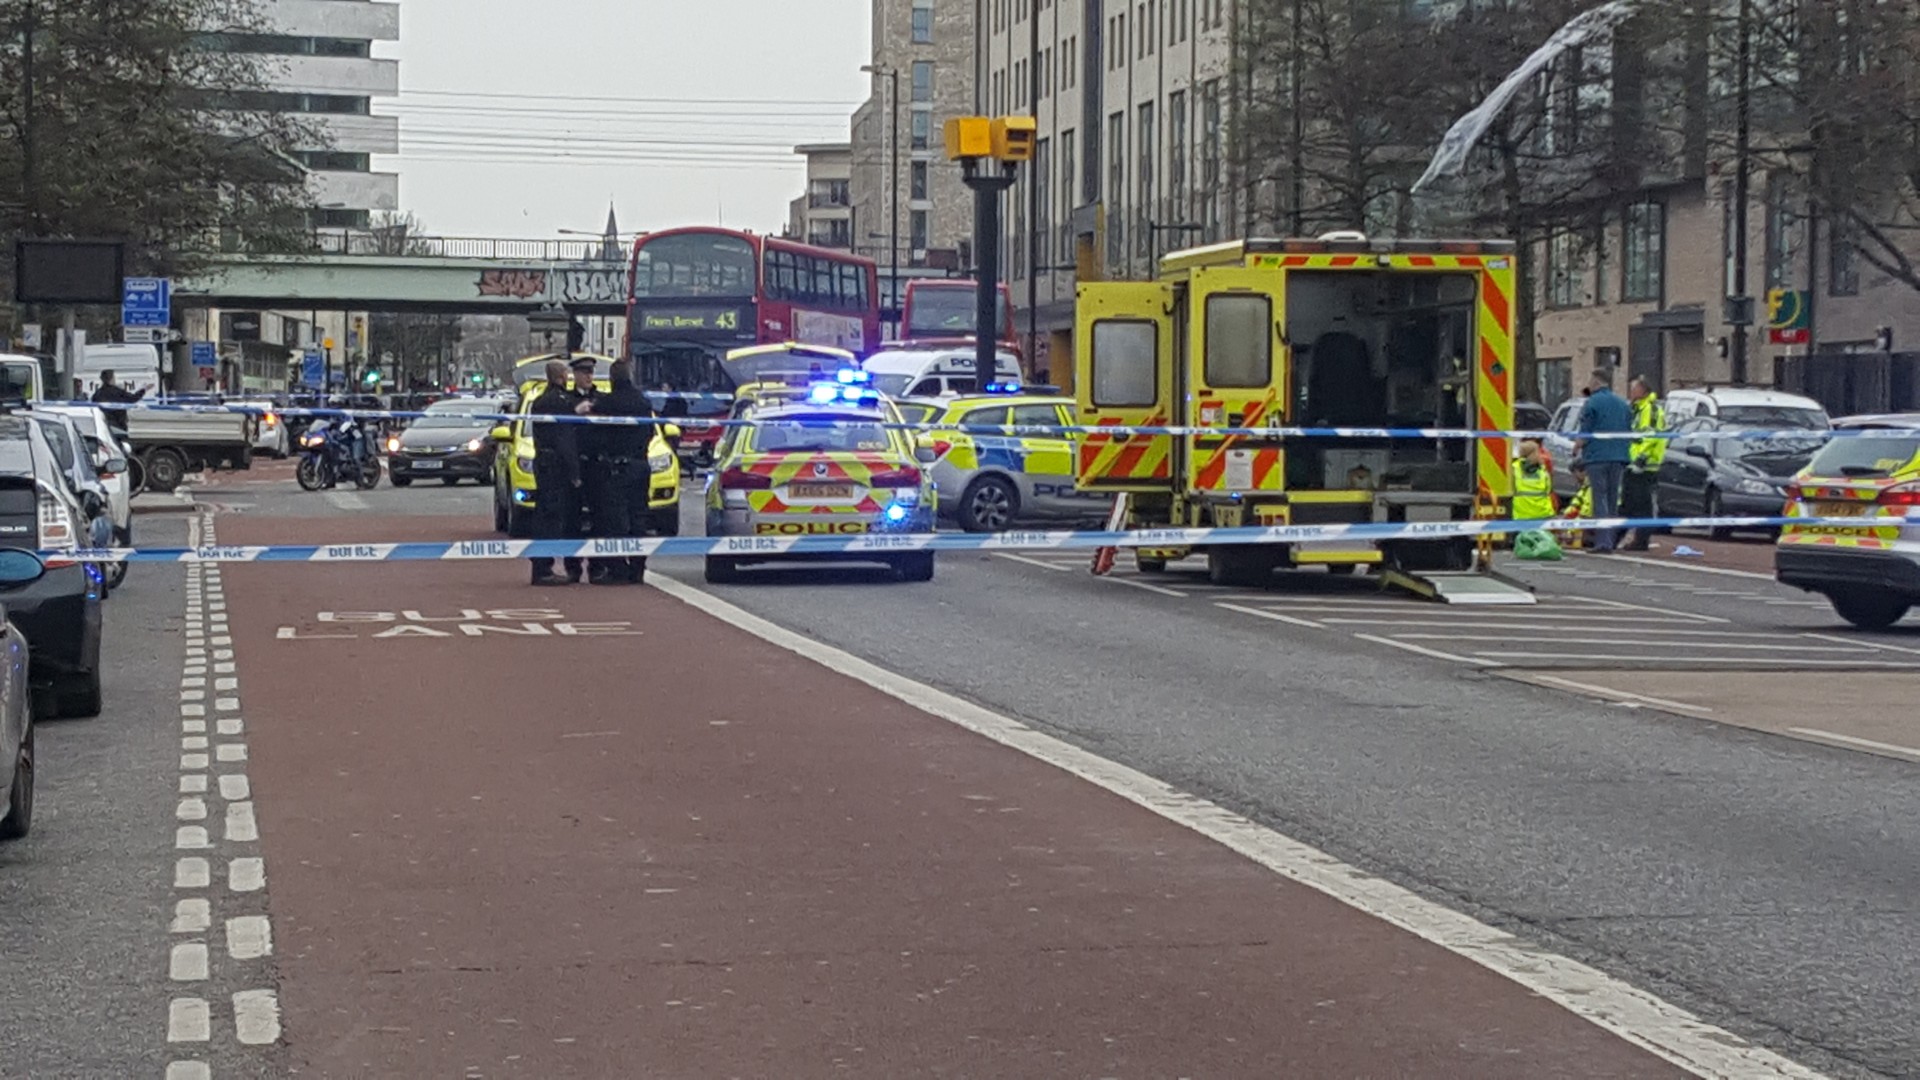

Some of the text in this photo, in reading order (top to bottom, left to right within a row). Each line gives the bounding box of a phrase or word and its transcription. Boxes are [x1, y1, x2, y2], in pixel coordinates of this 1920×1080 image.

[715, 312, 736, 328] 43
[317, 609, 565, 622] BUS
[276, 622, 644, 640] LANE
